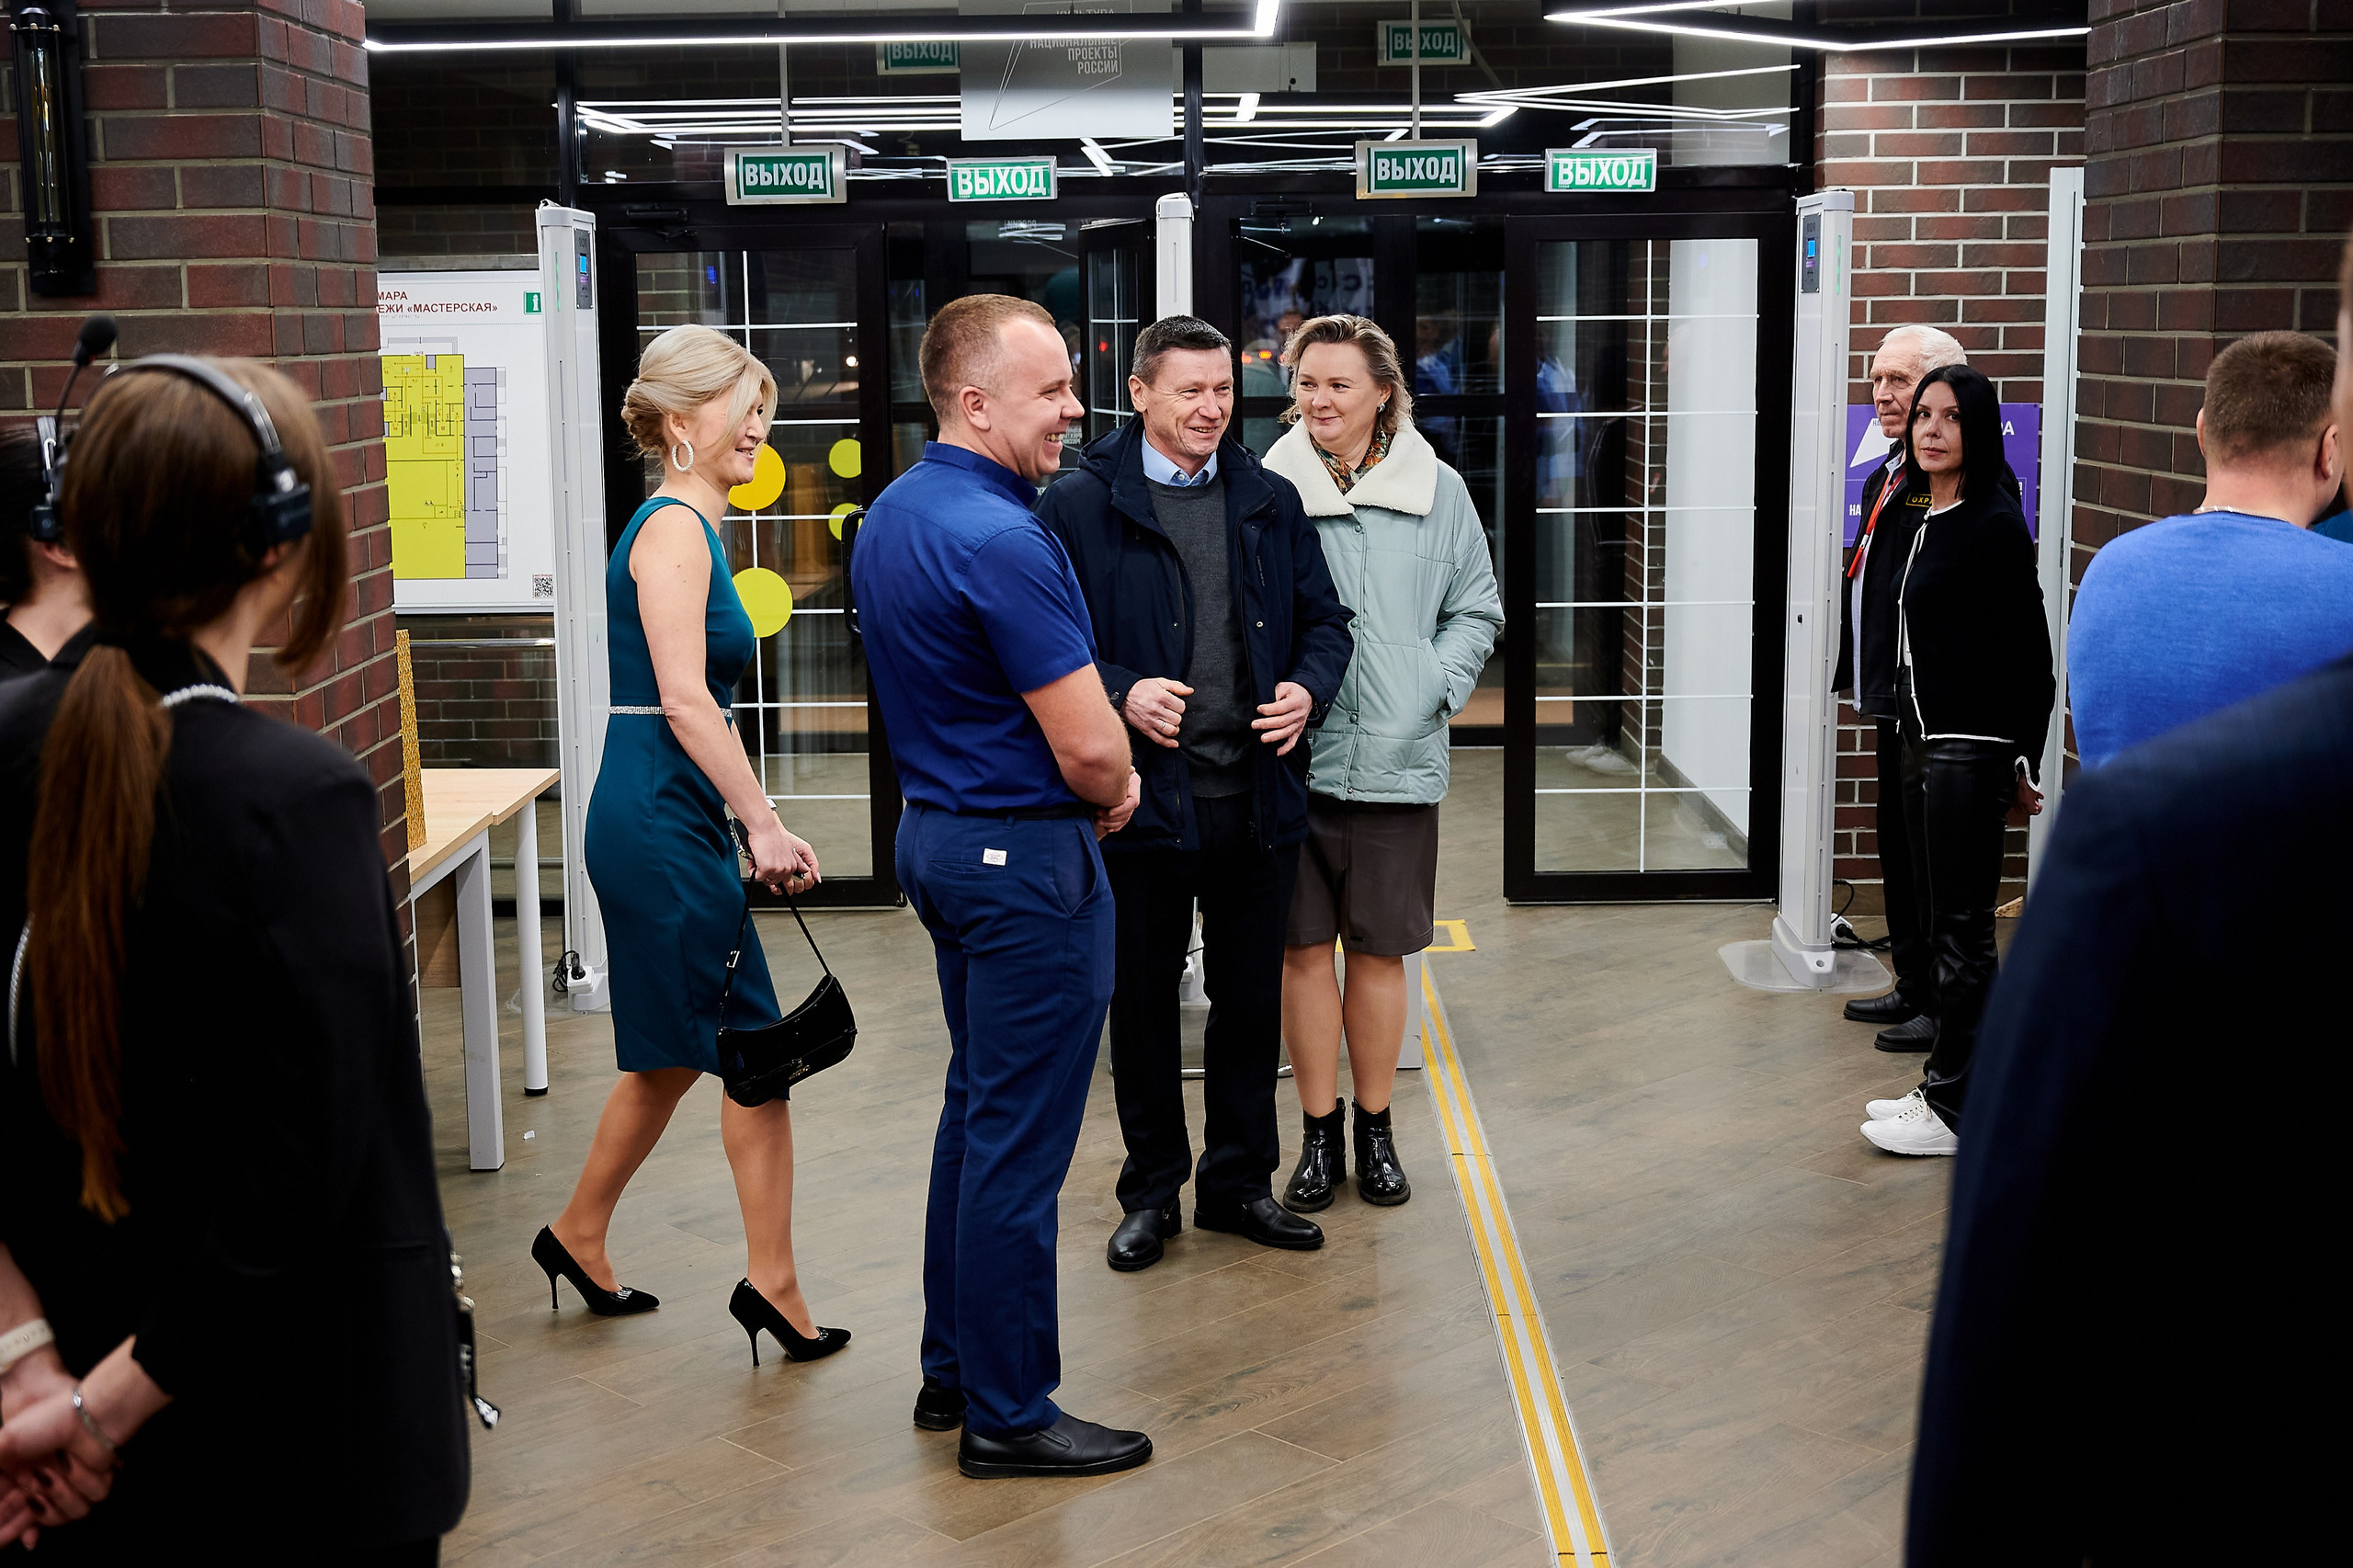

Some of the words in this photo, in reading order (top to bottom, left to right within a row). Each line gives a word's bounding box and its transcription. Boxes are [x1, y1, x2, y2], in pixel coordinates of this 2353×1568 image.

[892, 41, 953, 62] ВЫХОД
[1068, 46, 1118, 61] ПРОЕКТЫ
[1077, 60, 1119, 74] РОССИИ
[745, 163, 824, 189] ВЫХОД
[1377, 156, 1457, 183] ВЫХОД
[1558, 158, 1647, 188] ВЫХОД
[958, 166, 1046, 196] ВЫХОД
[407, 302, 498, 313] «МАСТЕРСКАЯ»
[2001, 420, 2015, 436] А
